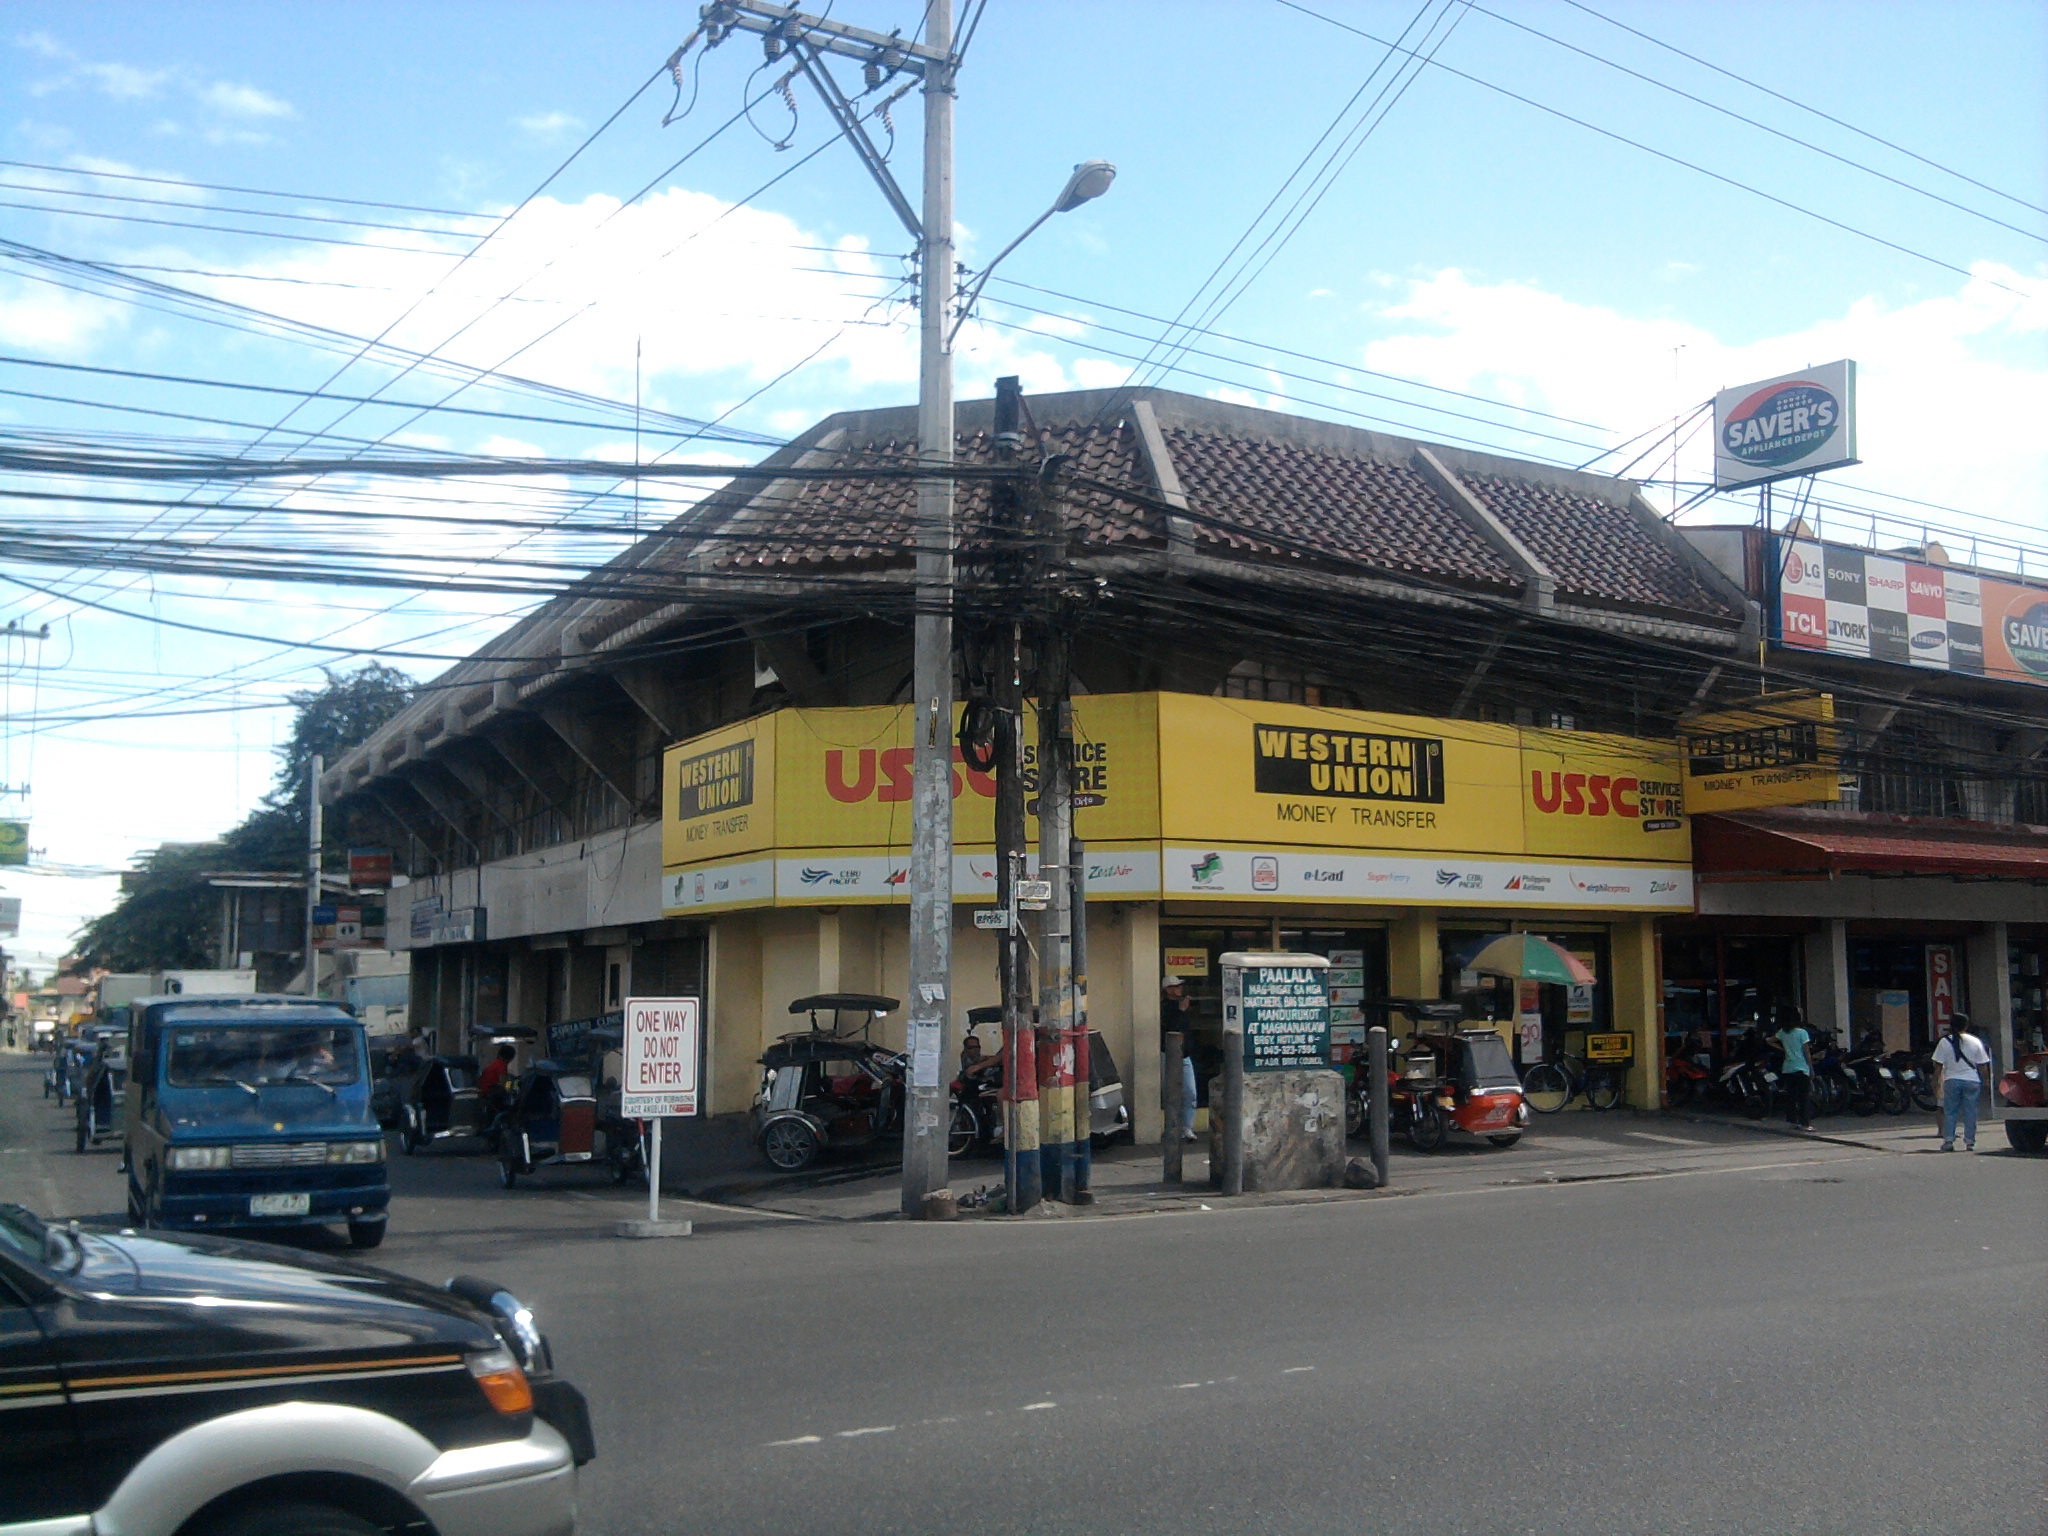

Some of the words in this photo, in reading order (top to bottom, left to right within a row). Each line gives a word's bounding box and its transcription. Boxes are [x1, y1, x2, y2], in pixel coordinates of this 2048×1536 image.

[1729, 401, 1834, 448] SAVER'S
[1742, 436, 1793, 456] APPLIANCE
[1794, 429, 1827, 444] DEPOT
[1804, 562, 1821, 579] LG
[1827, 568, 1861, 583] SONY
[1868, 576, 1904, 590] SHARP
[1910, 581, 1942, 598] SANYO
[1786, 610, 1824, 635] TCL
[1836, 621, 1866, 640] YORK
[1024, 743, 1107, 764] SICE
[1258, 730, 1411, 767] WESTERN
[682, 747, 740, 788] WESTERN
[1310, 763, 1412, 796] UNION
[1640, 780, 1681, 797] SERVICE
[1704, 777, 1743, 791] MONEY
[1751, 770, 1812, 786] TRANSFER
[698, 777, 740, 810] UNION
[1532, 770, 1640, 818] USSC
[1277, 803, 1337, 823] MONEY
[1351, 807, 1437, 829] TRANSFER
[687, 823, 709, 842] MONEY
[713, 813, 749, 838] TRANSFER
[1259, 968, 1314, 983] PAALALA
[636, 1010, 660, 1032] ONE
[663, 1010, 688, 1032] WAY
[1257, 1008, 1321, 1021] MANDURUKOT
[1247, 1022, 1260, 1034] AT
[1261, 1021, 1326, 1034] MAGNANAKAW
[643, 1036, 658, 1058] DO
[660, 1036, 679, 1058] NOT
[640, 1062, 682, 1084] ENTER
